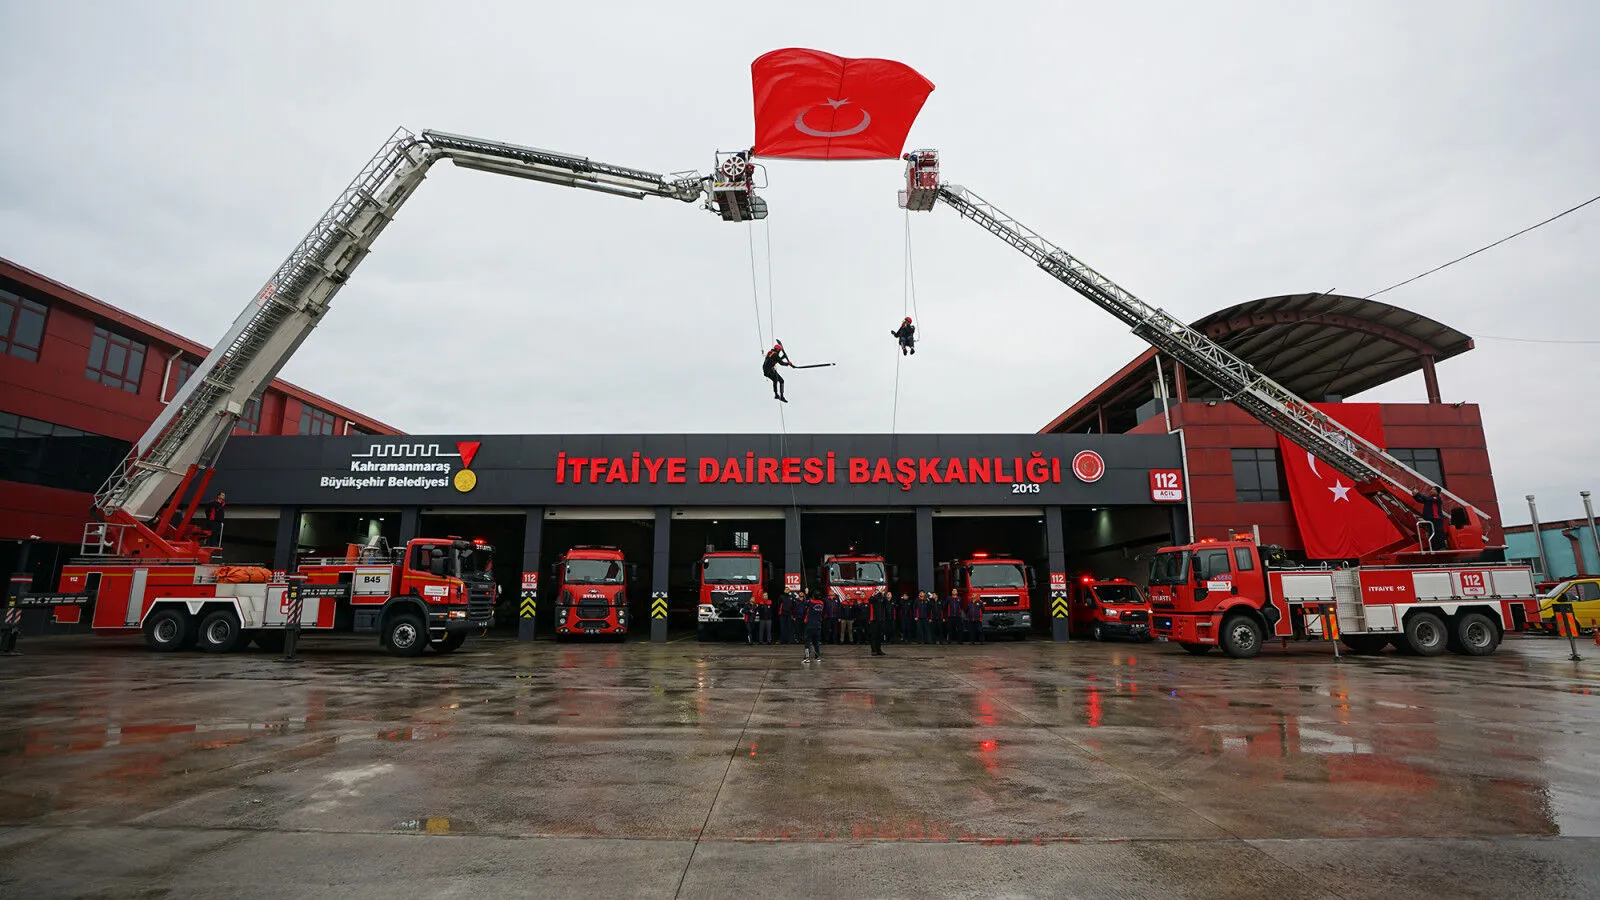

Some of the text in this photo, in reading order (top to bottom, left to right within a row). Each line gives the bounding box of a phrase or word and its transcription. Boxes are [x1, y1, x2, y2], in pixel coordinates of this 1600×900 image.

[350, 461, 451, 474] Kahramanmaraş
[556, 451, 687, 483] İTFAİYE
[699, 451, 835, 484] DAİRESİ
[849, 451, 1061, 491] BAŞKANLIĞI
[320, 476, 449, 489] Büyükşehir Belediyesi
[1154, 472, 1178, 488] 112
[1012, 483, 1040, 493] 2013
[524, 574, 537, 583] 112
[787, 575, 800, 584] 112
[1051, 574, 1064, 583] 112
[1463, 574, 1481, 586] 112
